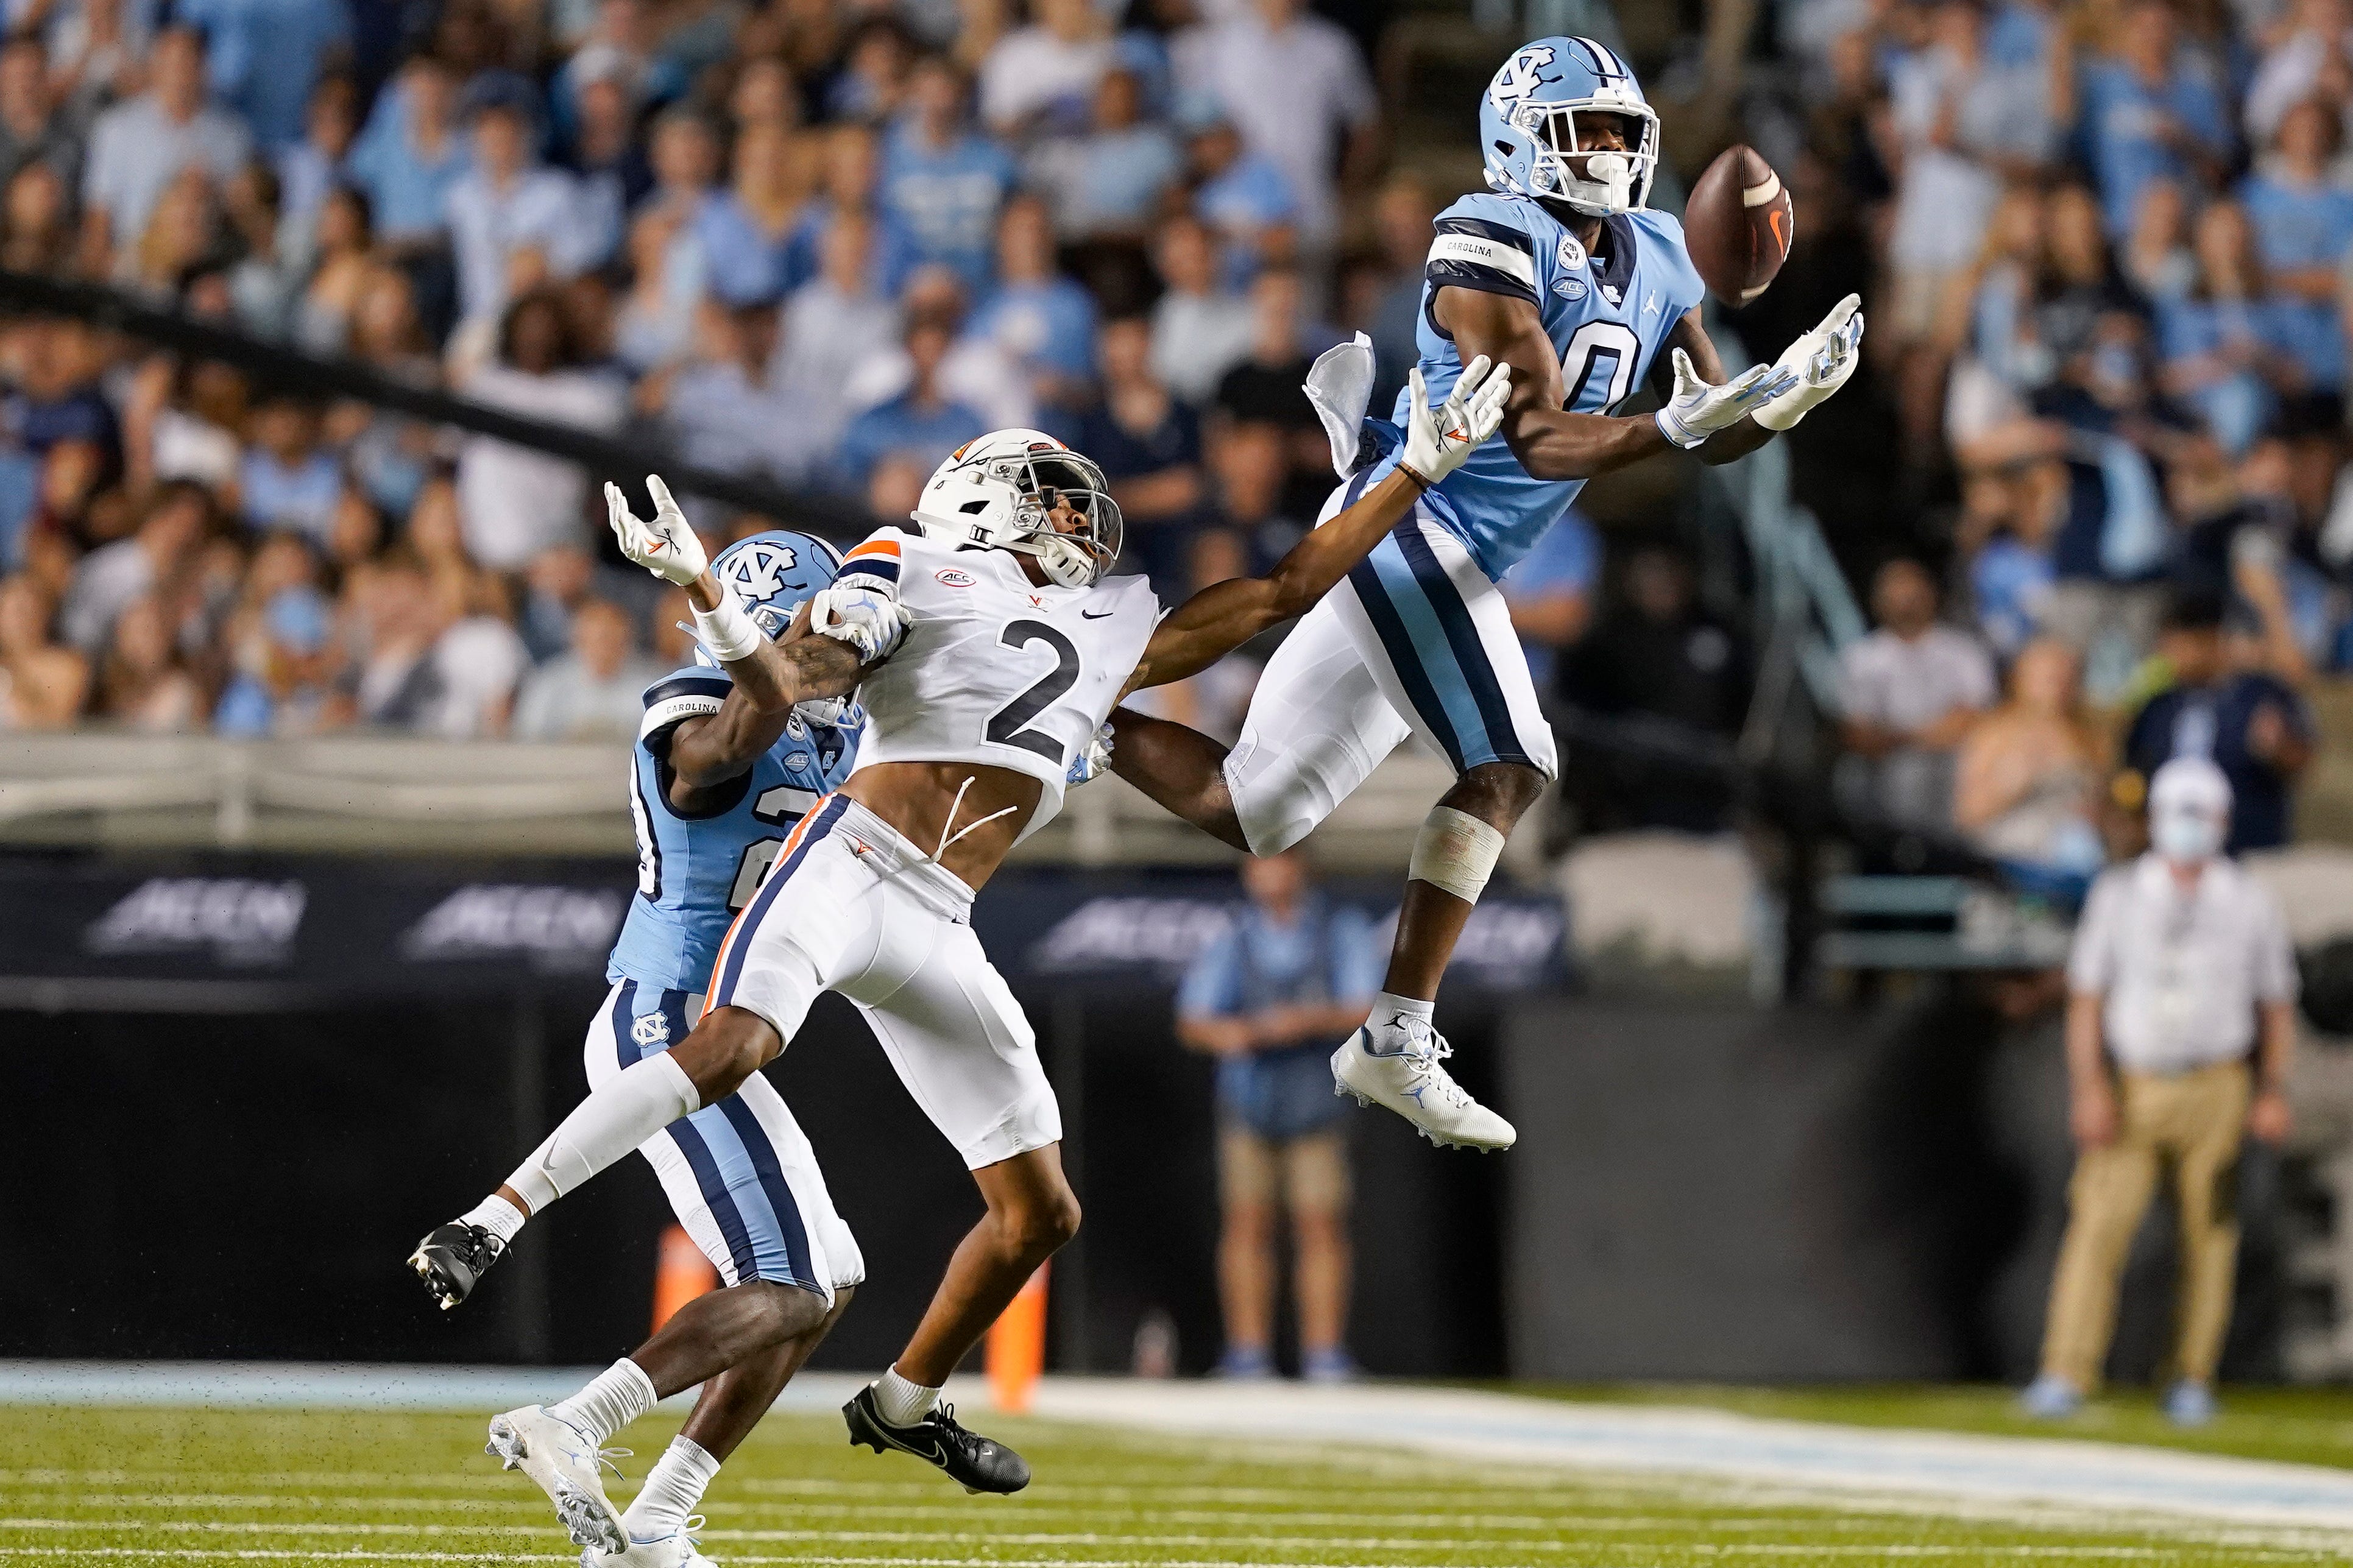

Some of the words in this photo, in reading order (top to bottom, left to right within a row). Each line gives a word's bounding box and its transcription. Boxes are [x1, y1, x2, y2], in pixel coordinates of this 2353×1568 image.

[1447, 242, 1491, 257] CAROLINA
[1556, 281, 1585, 292] ACC
[1561, 319, 1643, 416] 0
[942, 573, 970, 582] ACC
[983, 618, 1082, 769] 2
[667, 703, 717, 714] CAROLINA
